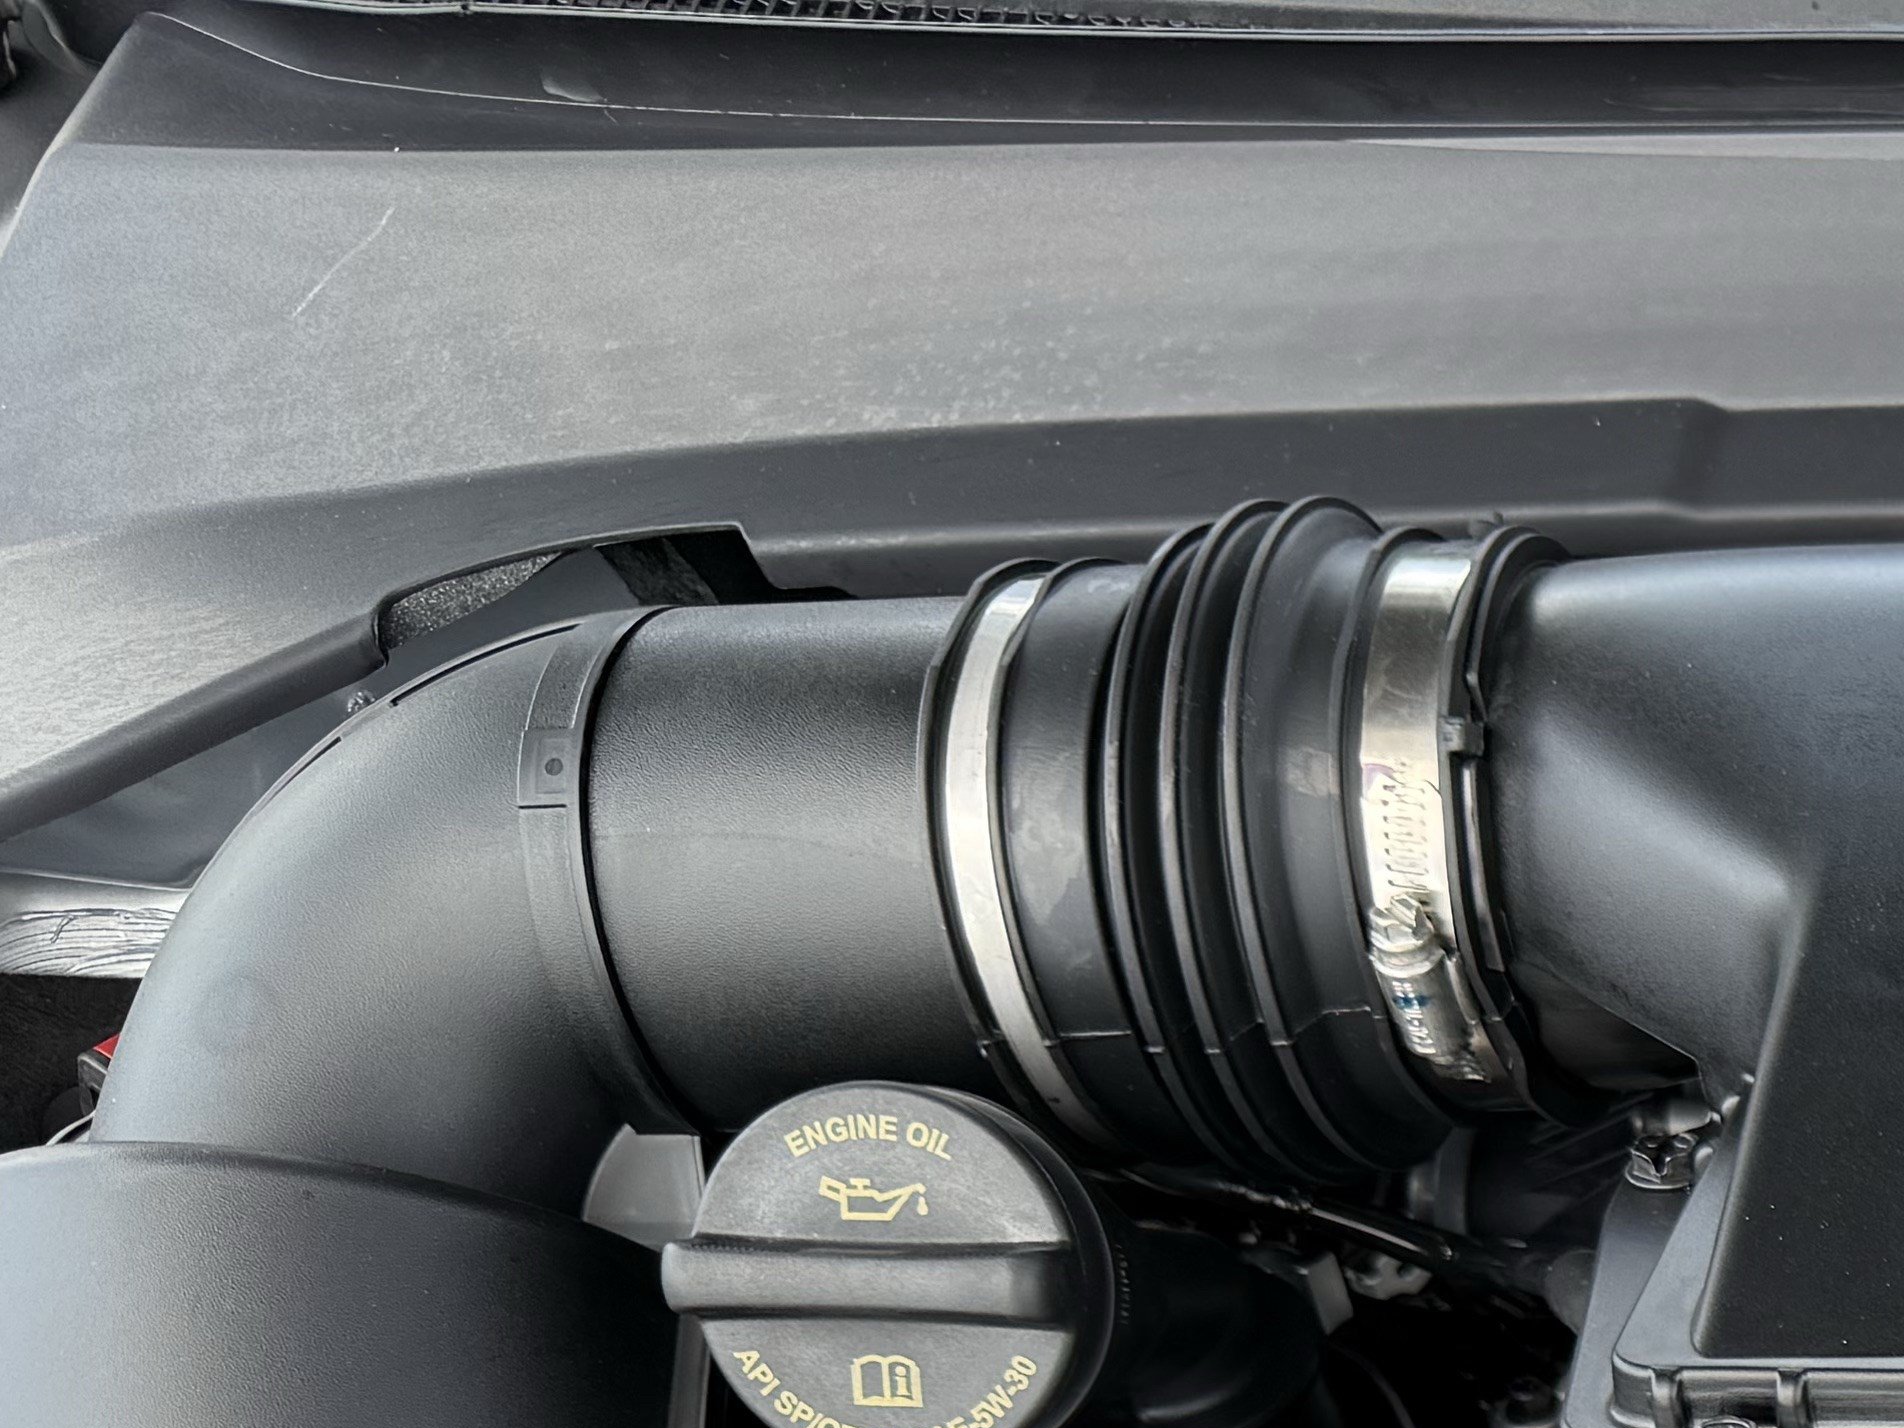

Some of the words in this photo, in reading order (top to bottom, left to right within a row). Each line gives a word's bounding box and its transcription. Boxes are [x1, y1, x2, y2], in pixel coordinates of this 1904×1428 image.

[783, 1113, 898, 1158] ENGINE
[905, 1121, 952, 1162] OIL
[733, 1350, 782, 1397] API
